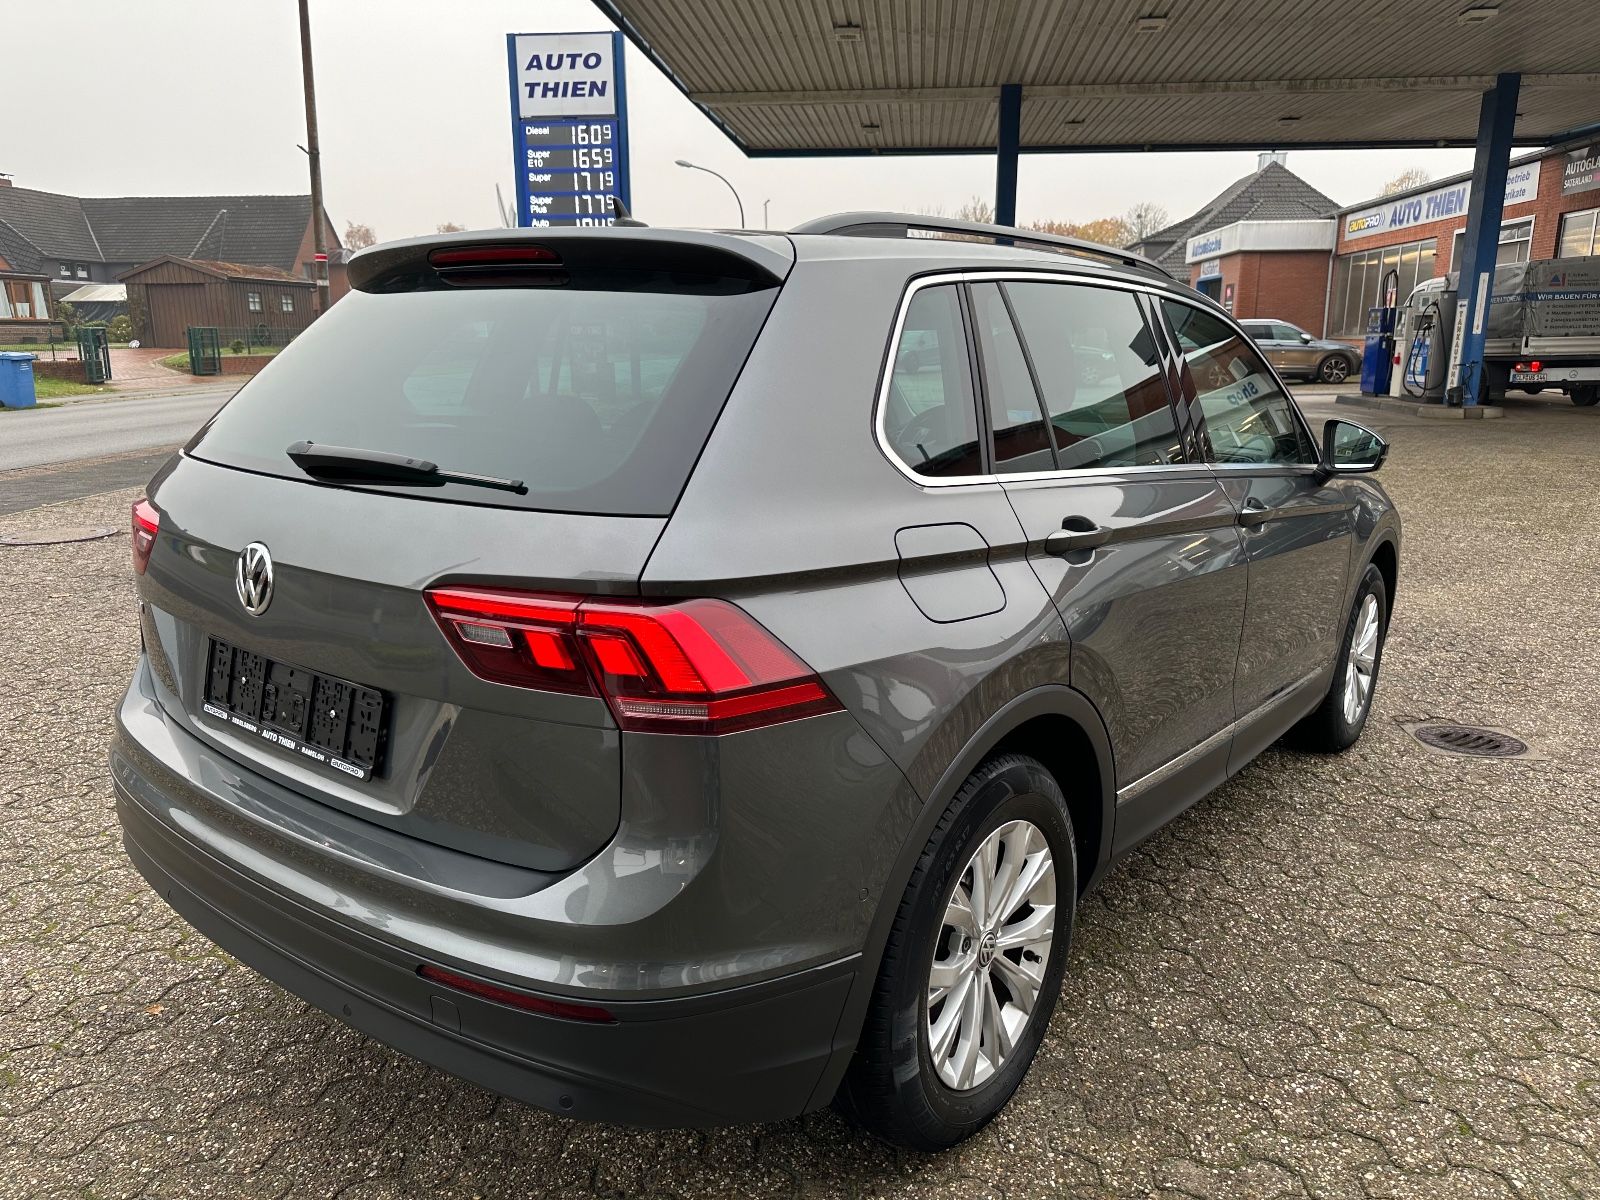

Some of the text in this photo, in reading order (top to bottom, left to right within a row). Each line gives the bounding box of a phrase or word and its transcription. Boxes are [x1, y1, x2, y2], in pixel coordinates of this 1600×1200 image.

[525, 52, 602, 71] AUTO
[524, 81, 607, 98] THIEN
[526, 126, 550, 135] Diesel
[527, 149, 551, 159] Super
[527, 159, 543, 168] E10
[528, 172, 552, 183] Super
[1563, 174, 1593, 189] SATERLAND
[529, 195, 553, 206] Super
[530, 205, 547, 214] Plus
[1389, 200, 1422, 228] AUTO
[1425, 188, 1466, 220] THIEN
[531, 218, 550, 227] Auto
[1449, 310, 1464, 389] TANKAUTOMA
[261, 729, 278, 742] AUTO
[278, 735, 296, 750] THIEN
